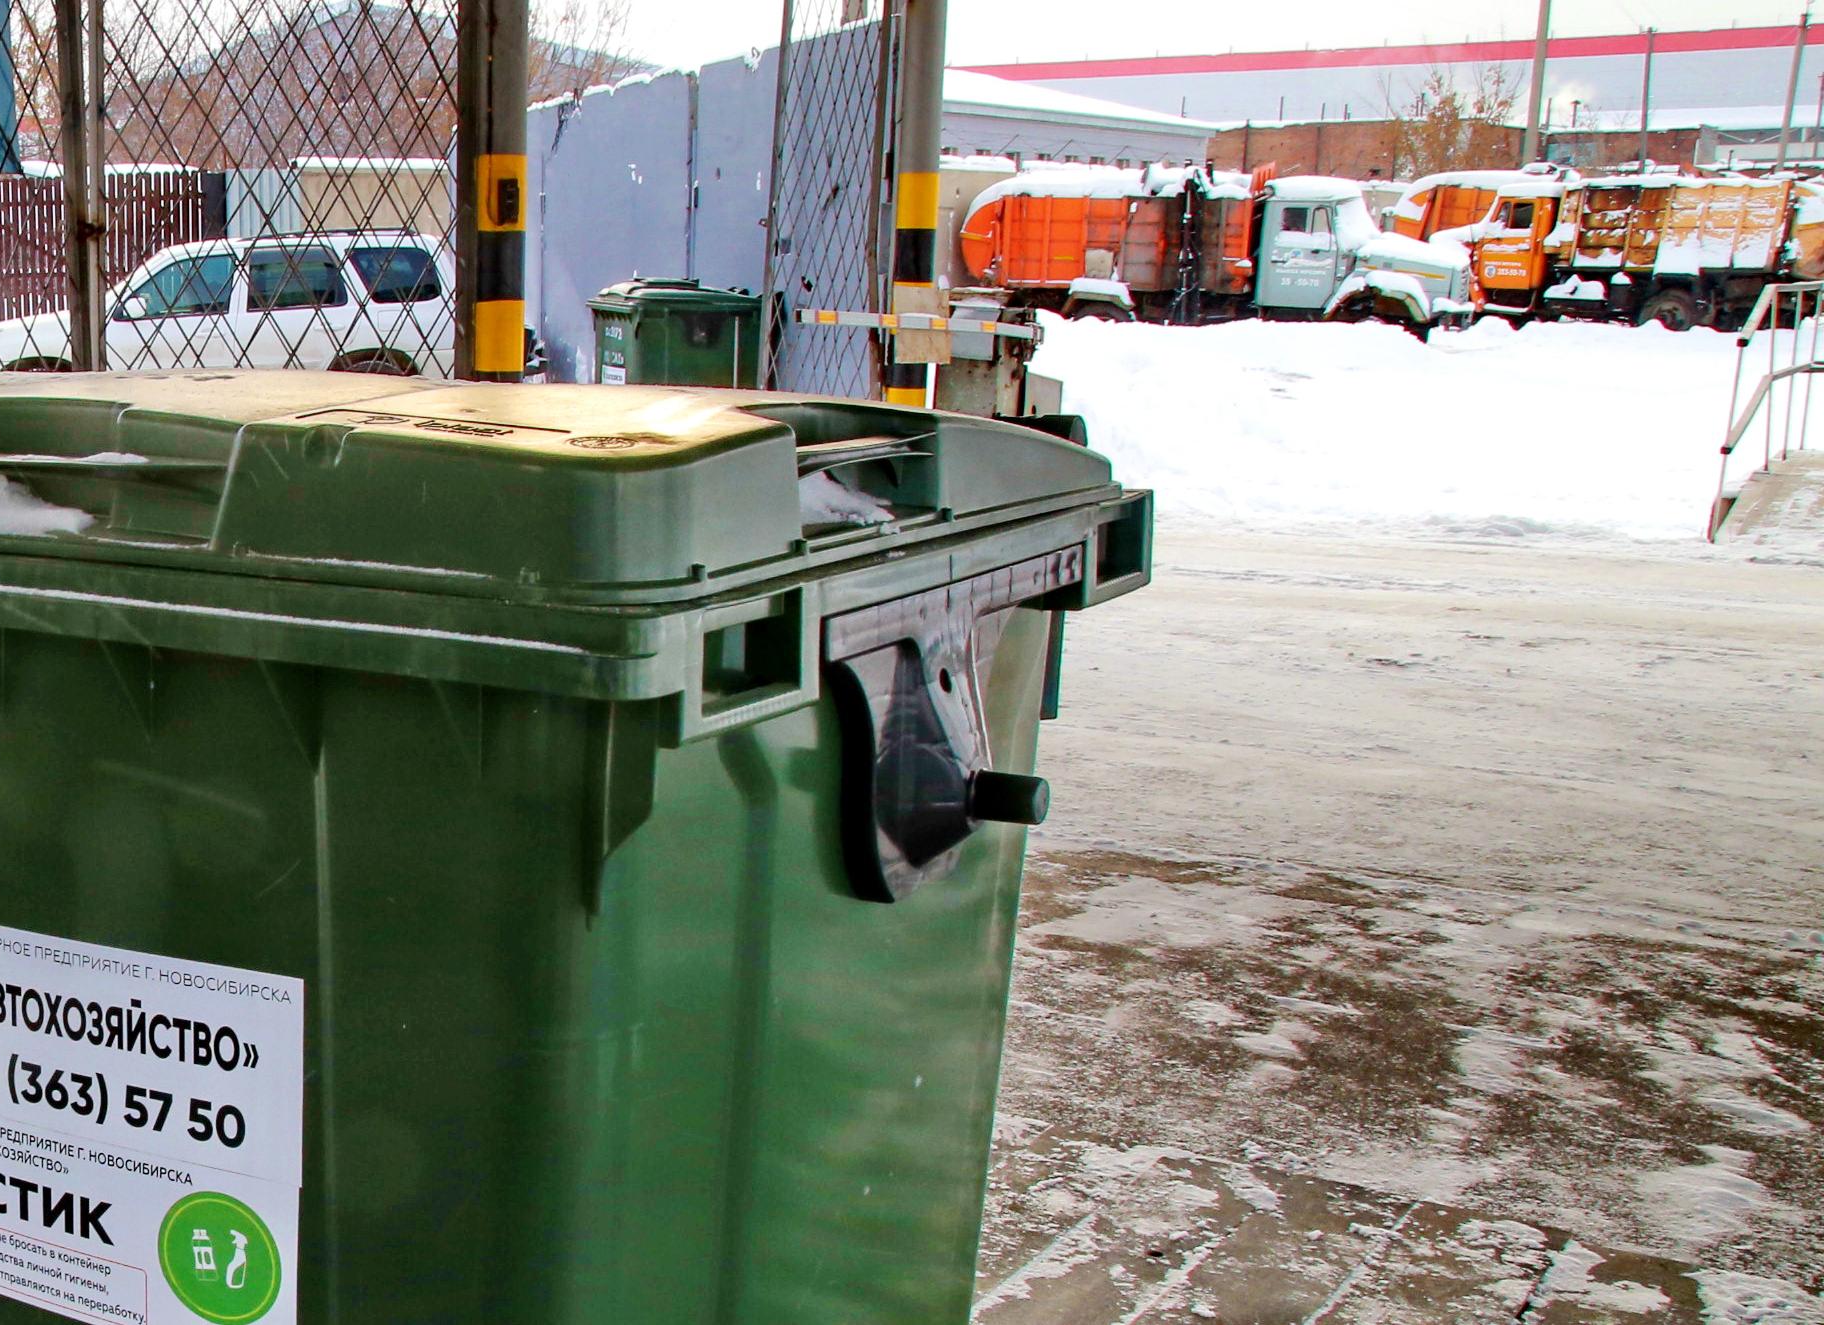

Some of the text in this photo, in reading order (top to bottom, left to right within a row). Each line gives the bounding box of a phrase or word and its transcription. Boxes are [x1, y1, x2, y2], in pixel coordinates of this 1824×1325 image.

[34, 946, 141, 978] ПРЕДПРИЯТИЕ
[145, 967, 155, 981] Г.
[160, 969, 292, 1004] НОВОСИБИРСКА
[8, 1053, 108, 1125] (363)
[123, 1084, 173, 1132] 57
[187, 1098, 246, 1149] 50
[77, 1148, 86, 1160] Г.
[89, 1150, 193, 1186] НОВОСИБИРСКА
[10, 1234, 47, 1256] бросать
[58, 1252, 111, 1276] контейнер
[26, 1261, 62, 1280] личной
[64, 1272, 109, 1295] гигиены,
[64, 1292, 76, 1302] на
[78, 1296, 146, 1324] переработку.
